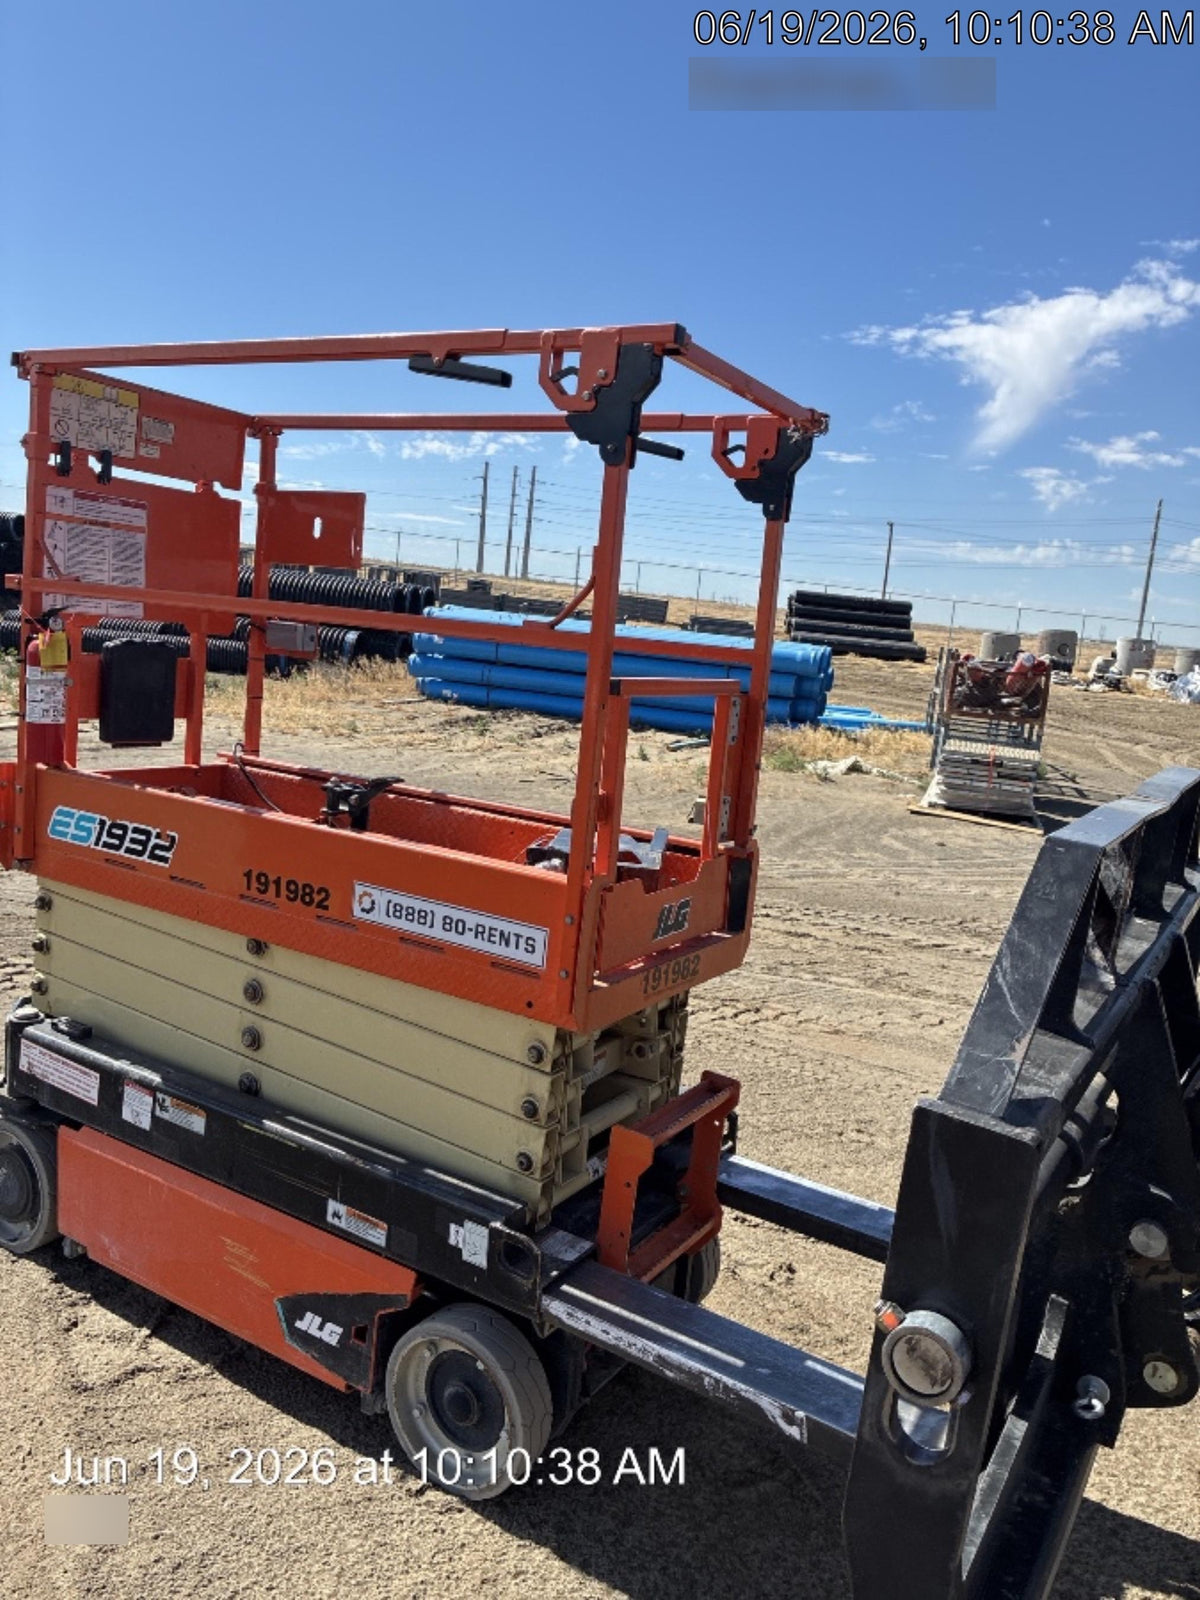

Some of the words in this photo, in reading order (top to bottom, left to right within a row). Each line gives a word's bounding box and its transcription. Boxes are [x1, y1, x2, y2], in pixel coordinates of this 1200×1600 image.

[48, 805, 178, 867] ES1932
[243, 869, 331, 911] 191982
[384, 898, 436, 930] (888)
[442, 914, 537, 956] 80-RENTS
[642, 954, 701, 995] 191982
[294, 1311, 344, 1347] JLG
